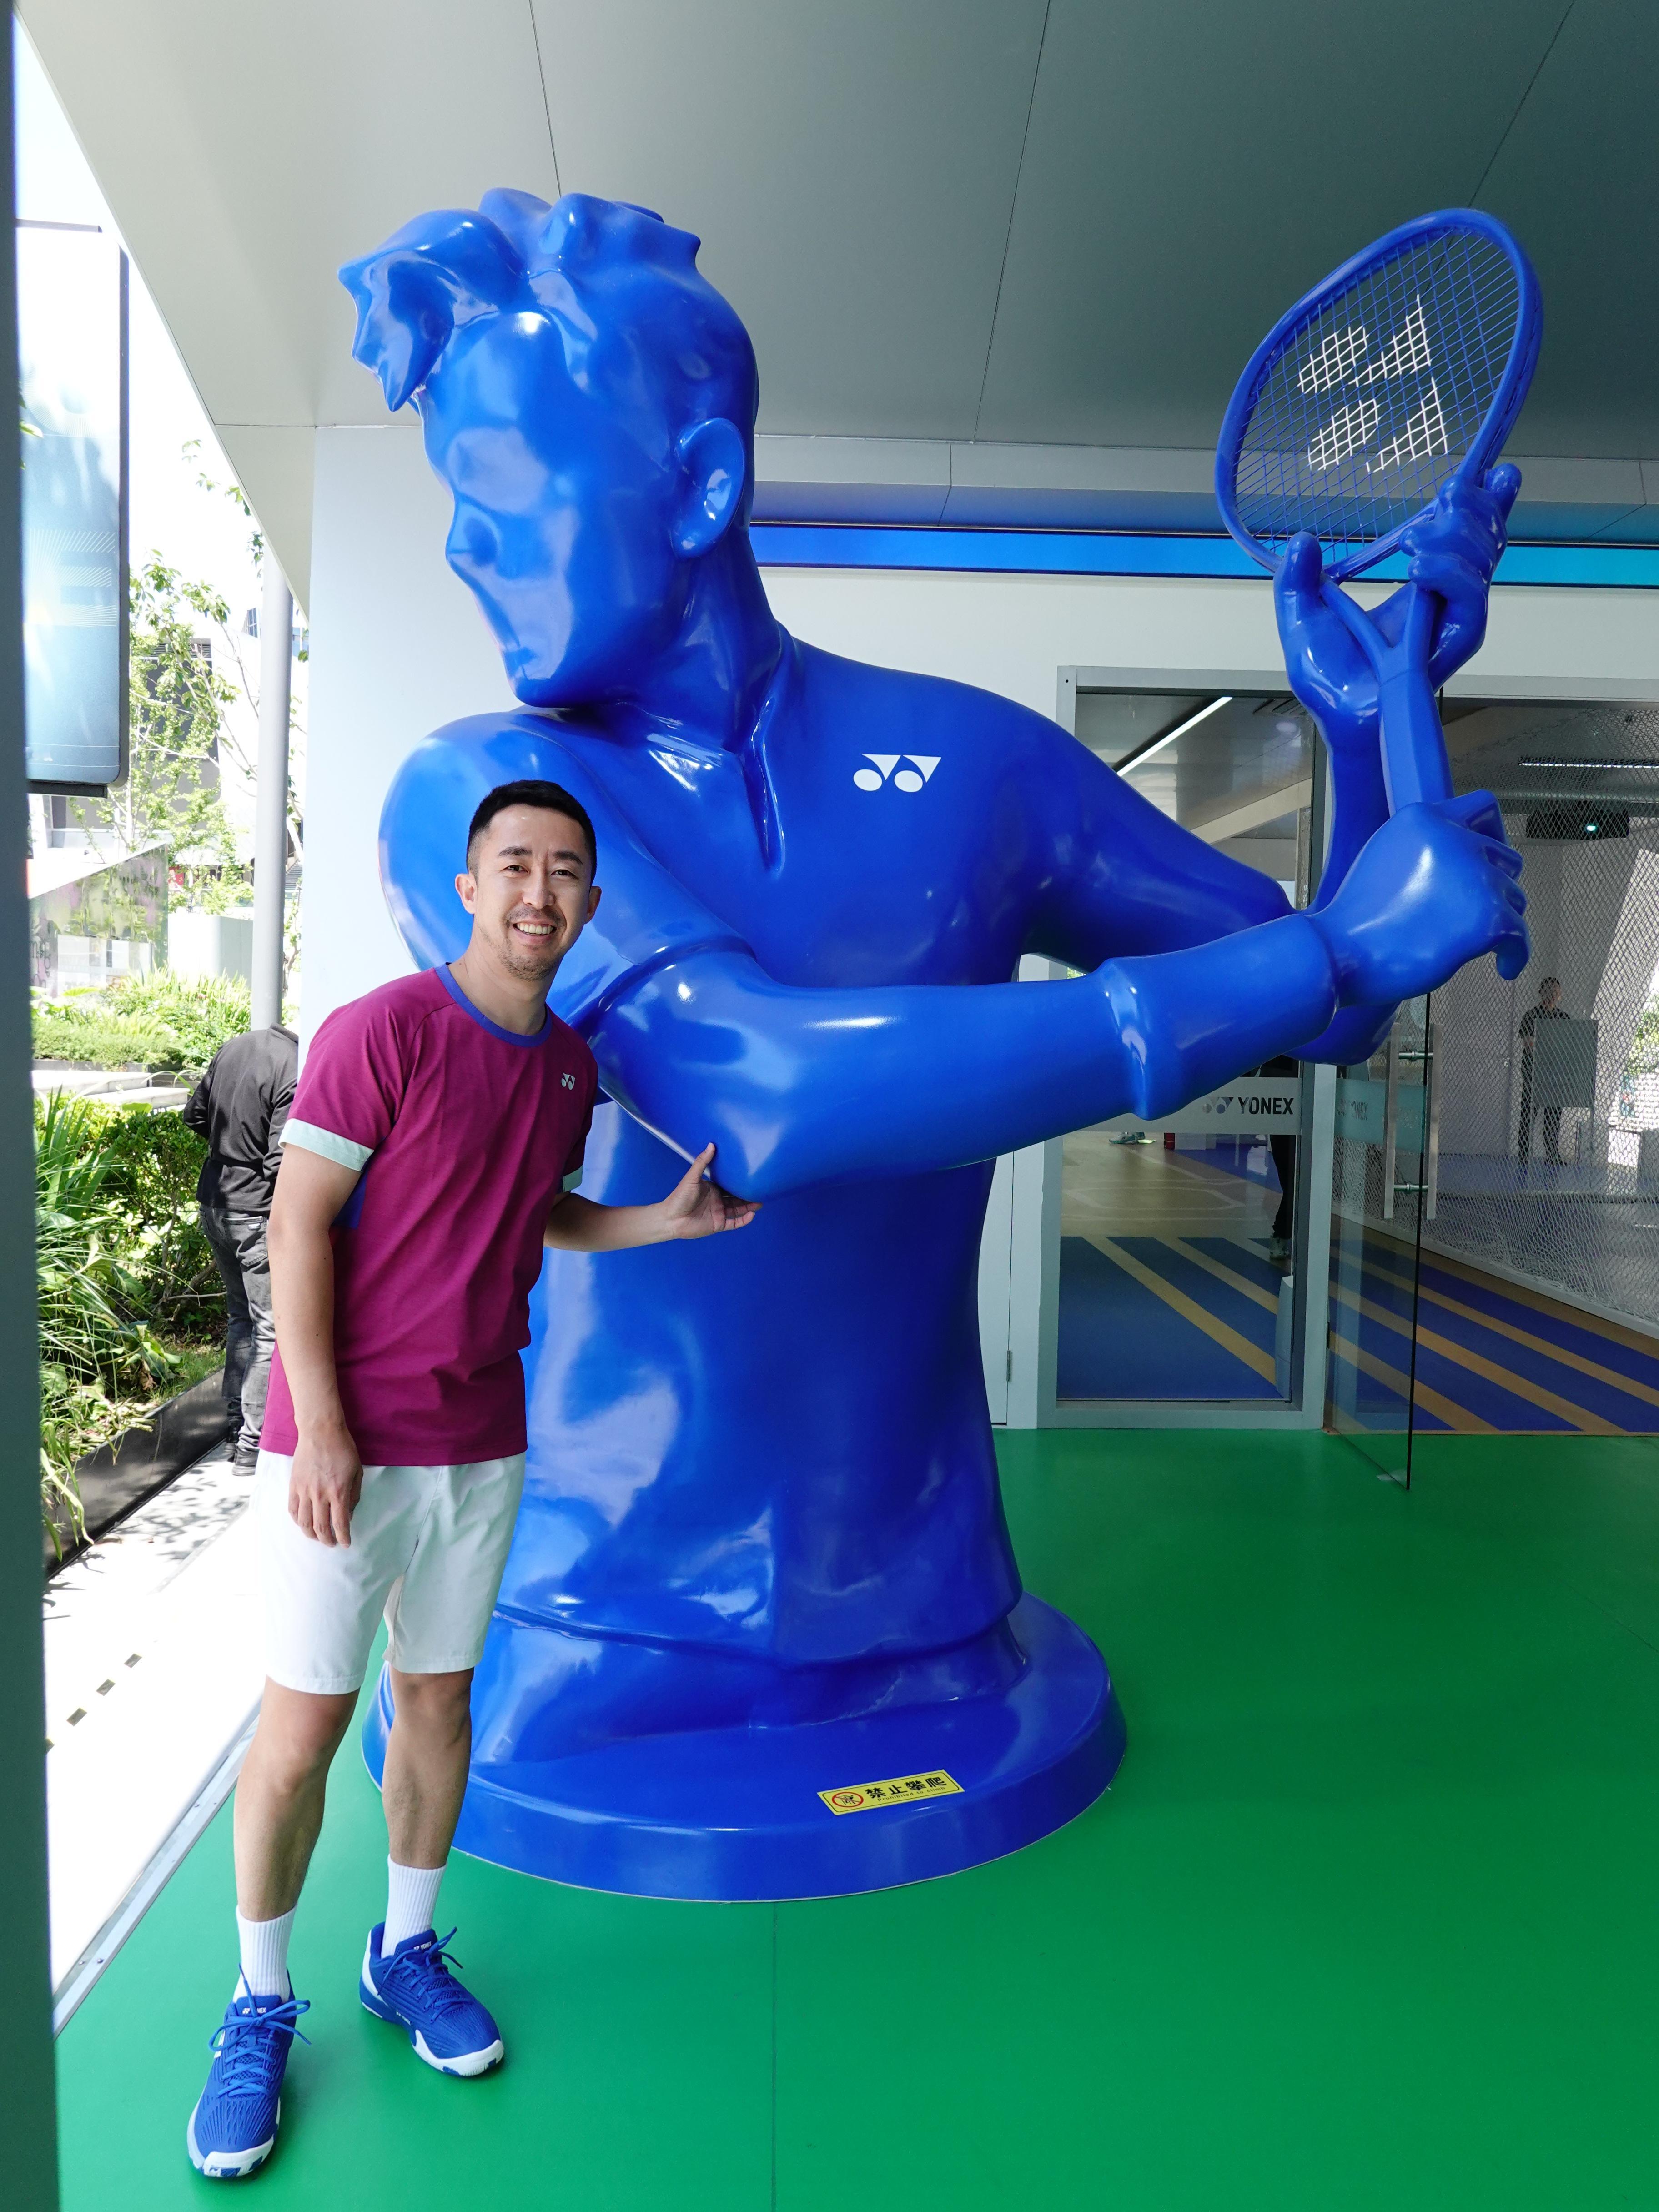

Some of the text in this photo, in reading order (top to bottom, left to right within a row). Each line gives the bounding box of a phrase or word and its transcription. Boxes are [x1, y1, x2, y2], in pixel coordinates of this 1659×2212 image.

[1238, 1097, 1294, 1115] YONEX
[865, 1777, 947, 1799] 禁止攀爬
